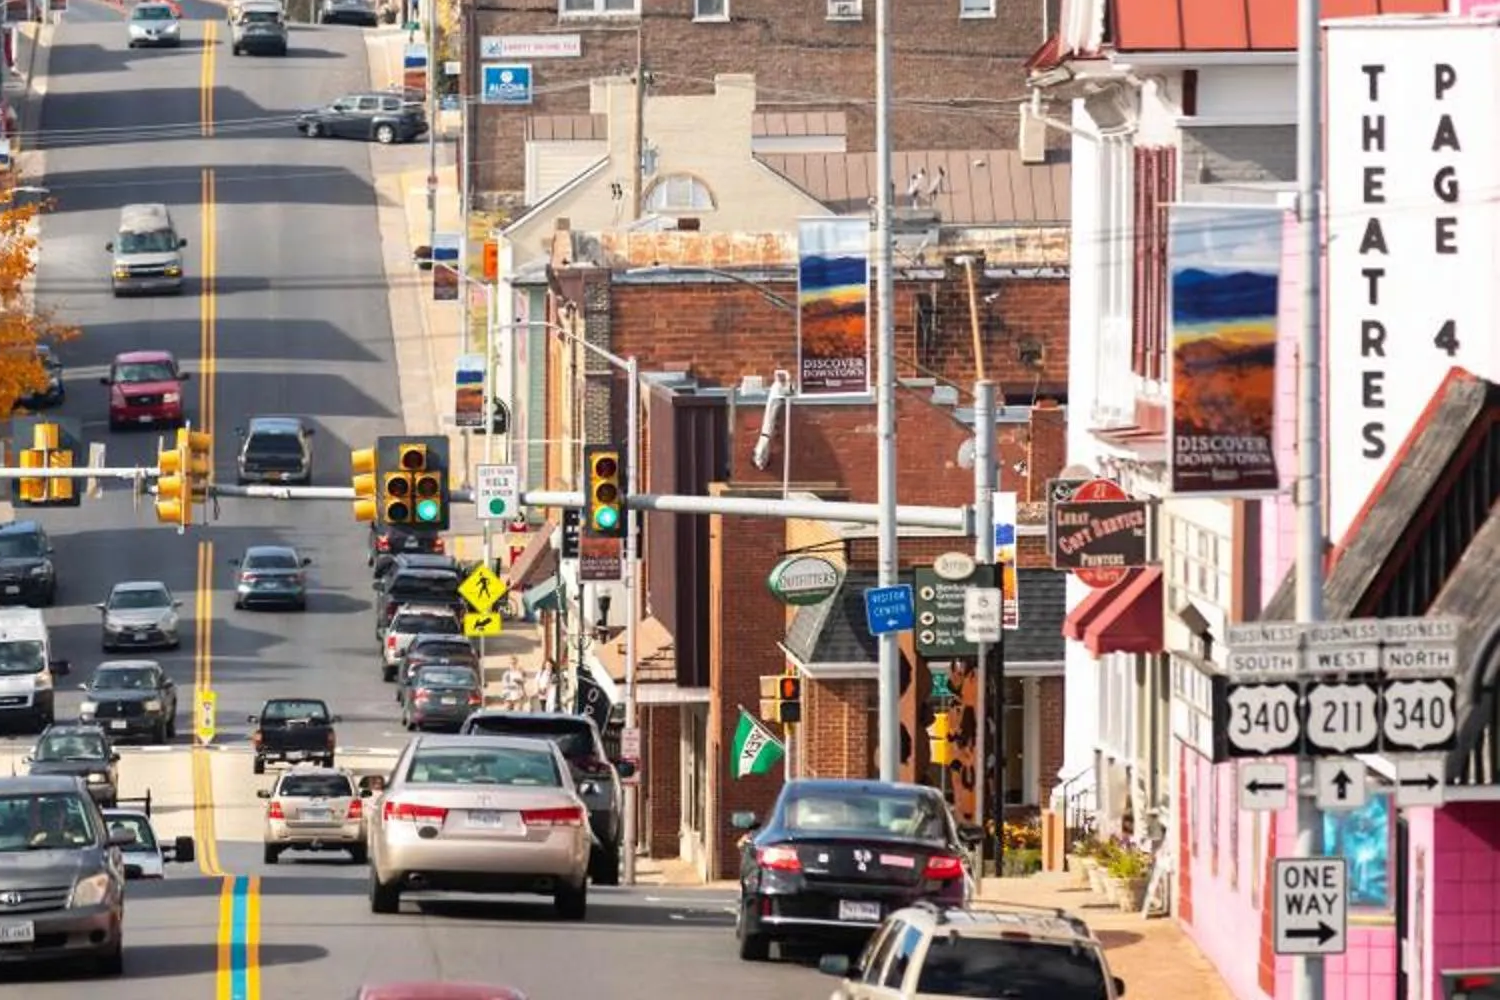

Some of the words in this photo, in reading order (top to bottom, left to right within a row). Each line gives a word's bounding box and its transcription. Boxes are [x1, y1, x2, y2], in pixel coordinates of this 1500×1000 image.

[1431, 63, 1461, 254] PAGE
[1358, 64, 1389, 459] THEATRES
[1433, 319, 1460, 357] 4
[803, 358, 865, 369] DISCOVER
[1176, 435, 1269, 451] DISCOVER
[1176, 452, 1271, 466] DOWNTOWN
[1090, 509, 1144, 538] SERVICE
[1081, 553, 1125, 567] PRINTERS
[780, 572, 835, 588] OUTFITTERS
[872, 590, 906, 603] VISITOR
[872, 604, 907, 617] CENTER
[1229, 627, 1295, 644] BUSINESS
[1309, 624, 1378, 643] BUSINESS
[1384, 622, 1450, 639] BUSINESS
[1234, 655, 1293, 671] SOUTH
[1318, 651, 1367, 667] WEST
[1389, 650, 1450, 667] NORTH
[1237, 700, 1290, 735] 340
[1322, 700, 1362, 733] 211
[1393, 696, 1445, 731] 340
[1284, 865, 1336, 889] ONE
[1284, 893, 1339, 915] WAY
